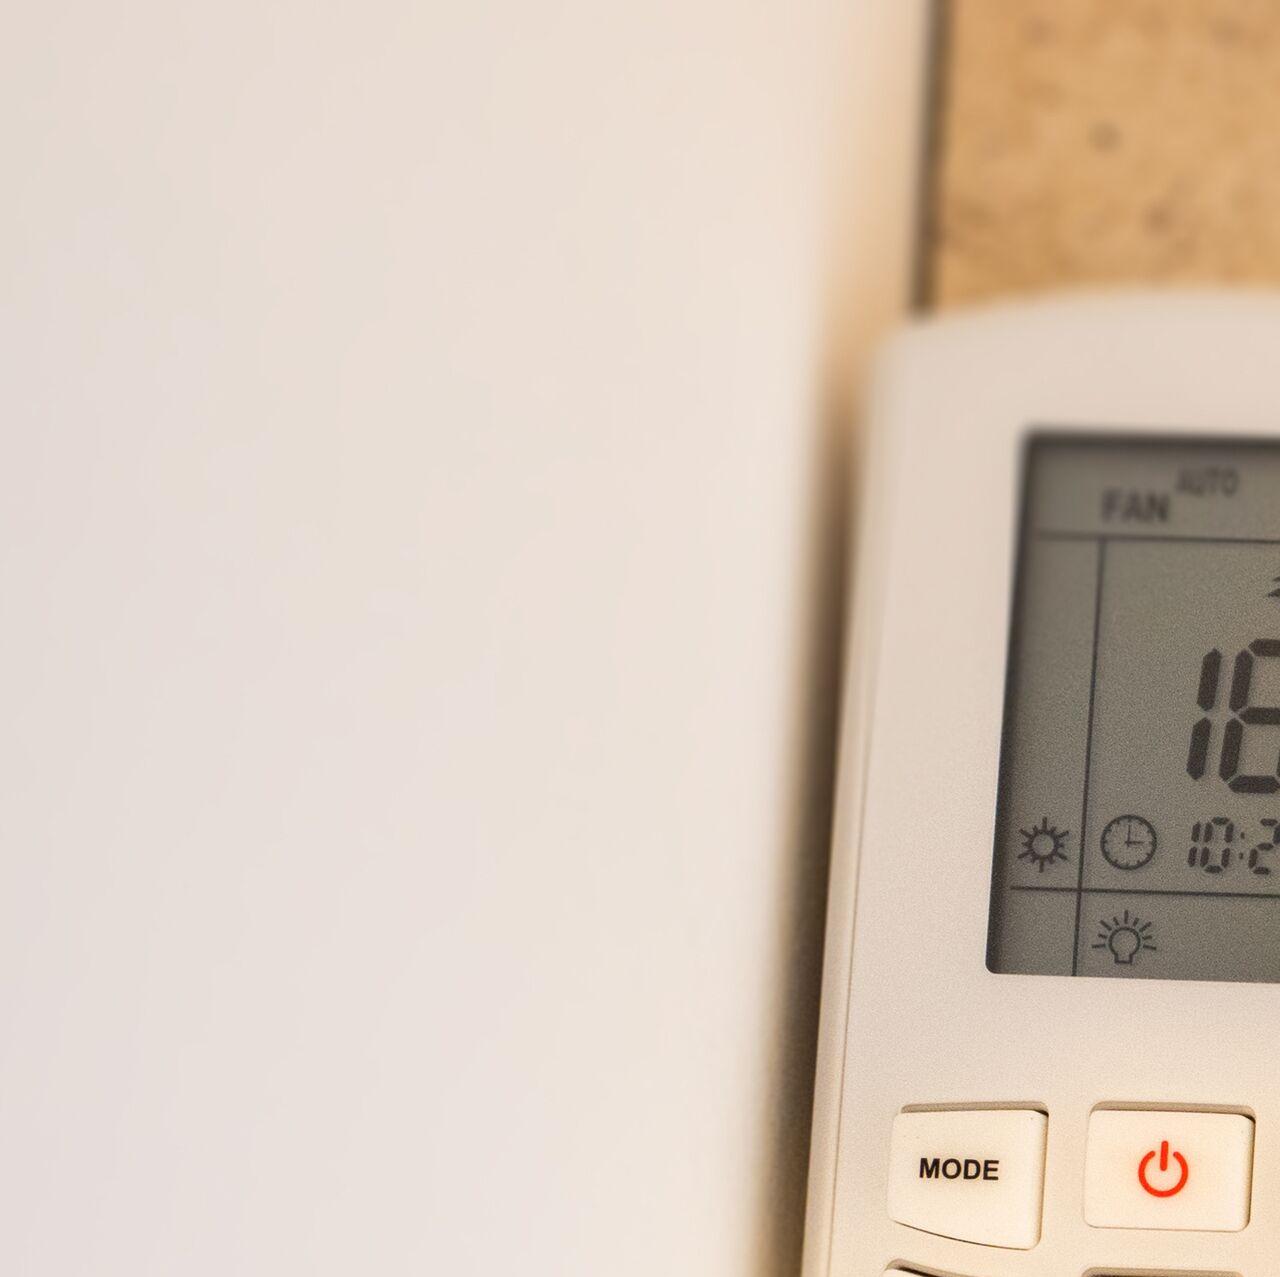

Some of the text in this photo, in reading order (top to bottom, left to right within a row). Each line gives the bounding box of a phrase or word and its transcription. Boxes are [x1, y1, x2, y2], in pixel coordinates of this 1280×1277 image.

[1176, 465, 1240, 496] AUTO
[1102, 489, 1170, 524] FAN
[917, 1156, 1001, 1182] MODE
